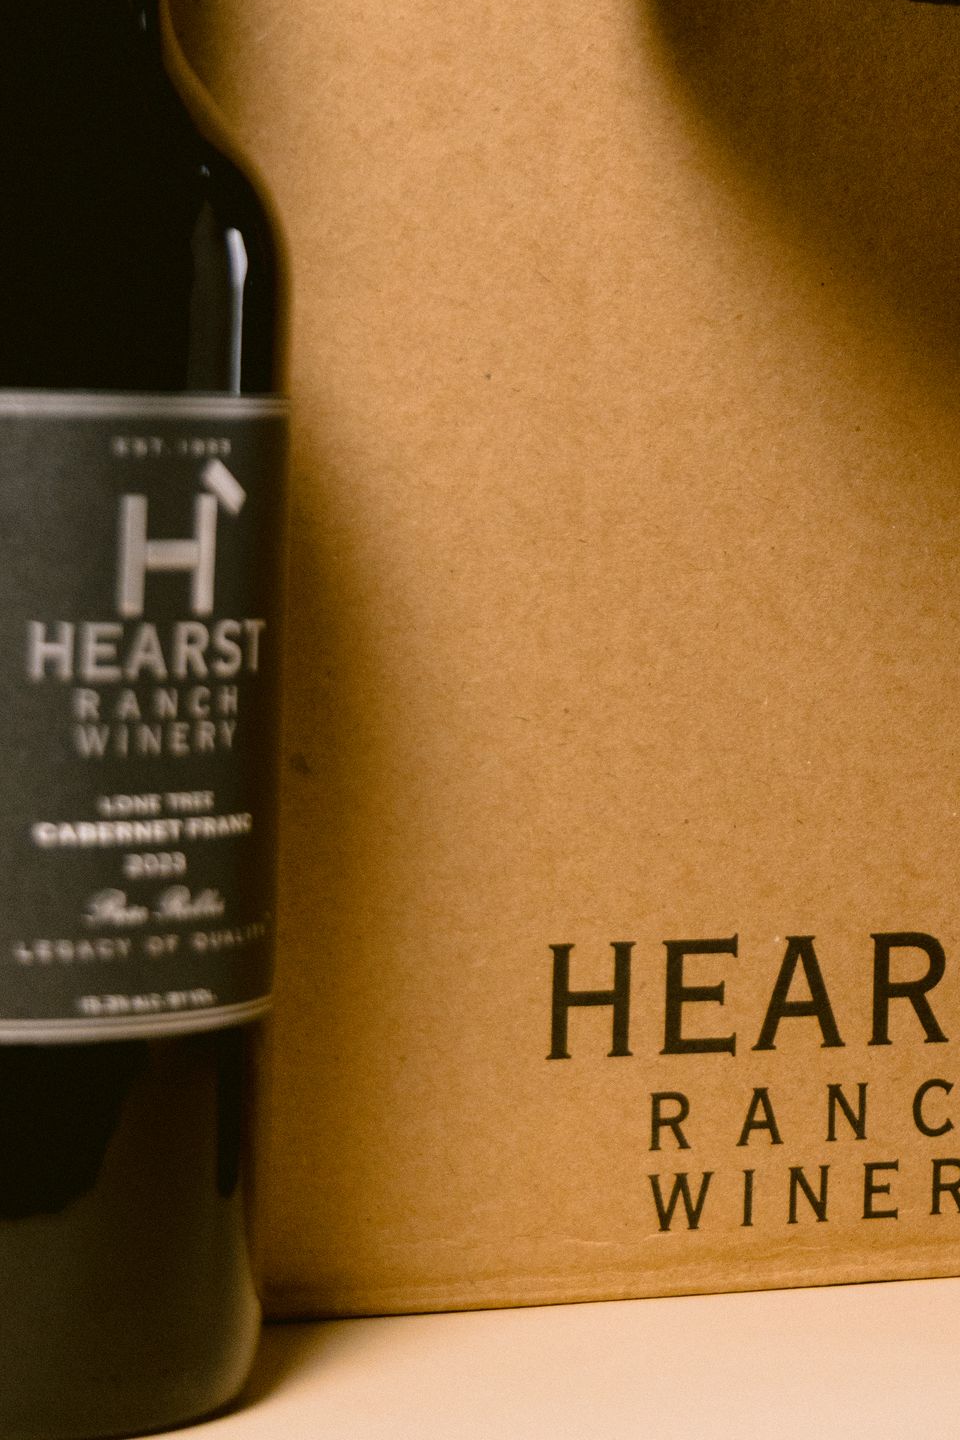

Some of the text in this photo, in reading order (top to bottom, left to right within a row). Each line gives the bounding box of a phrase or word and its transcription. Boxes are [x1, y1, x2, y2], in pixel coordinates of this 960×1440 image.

[26, 618, 266, 682] HEARST
[73, 685, 238, 720] RANCH
[73, 720, 237, 757] WINERY
[32, 819, 183, 847] CABERNET
